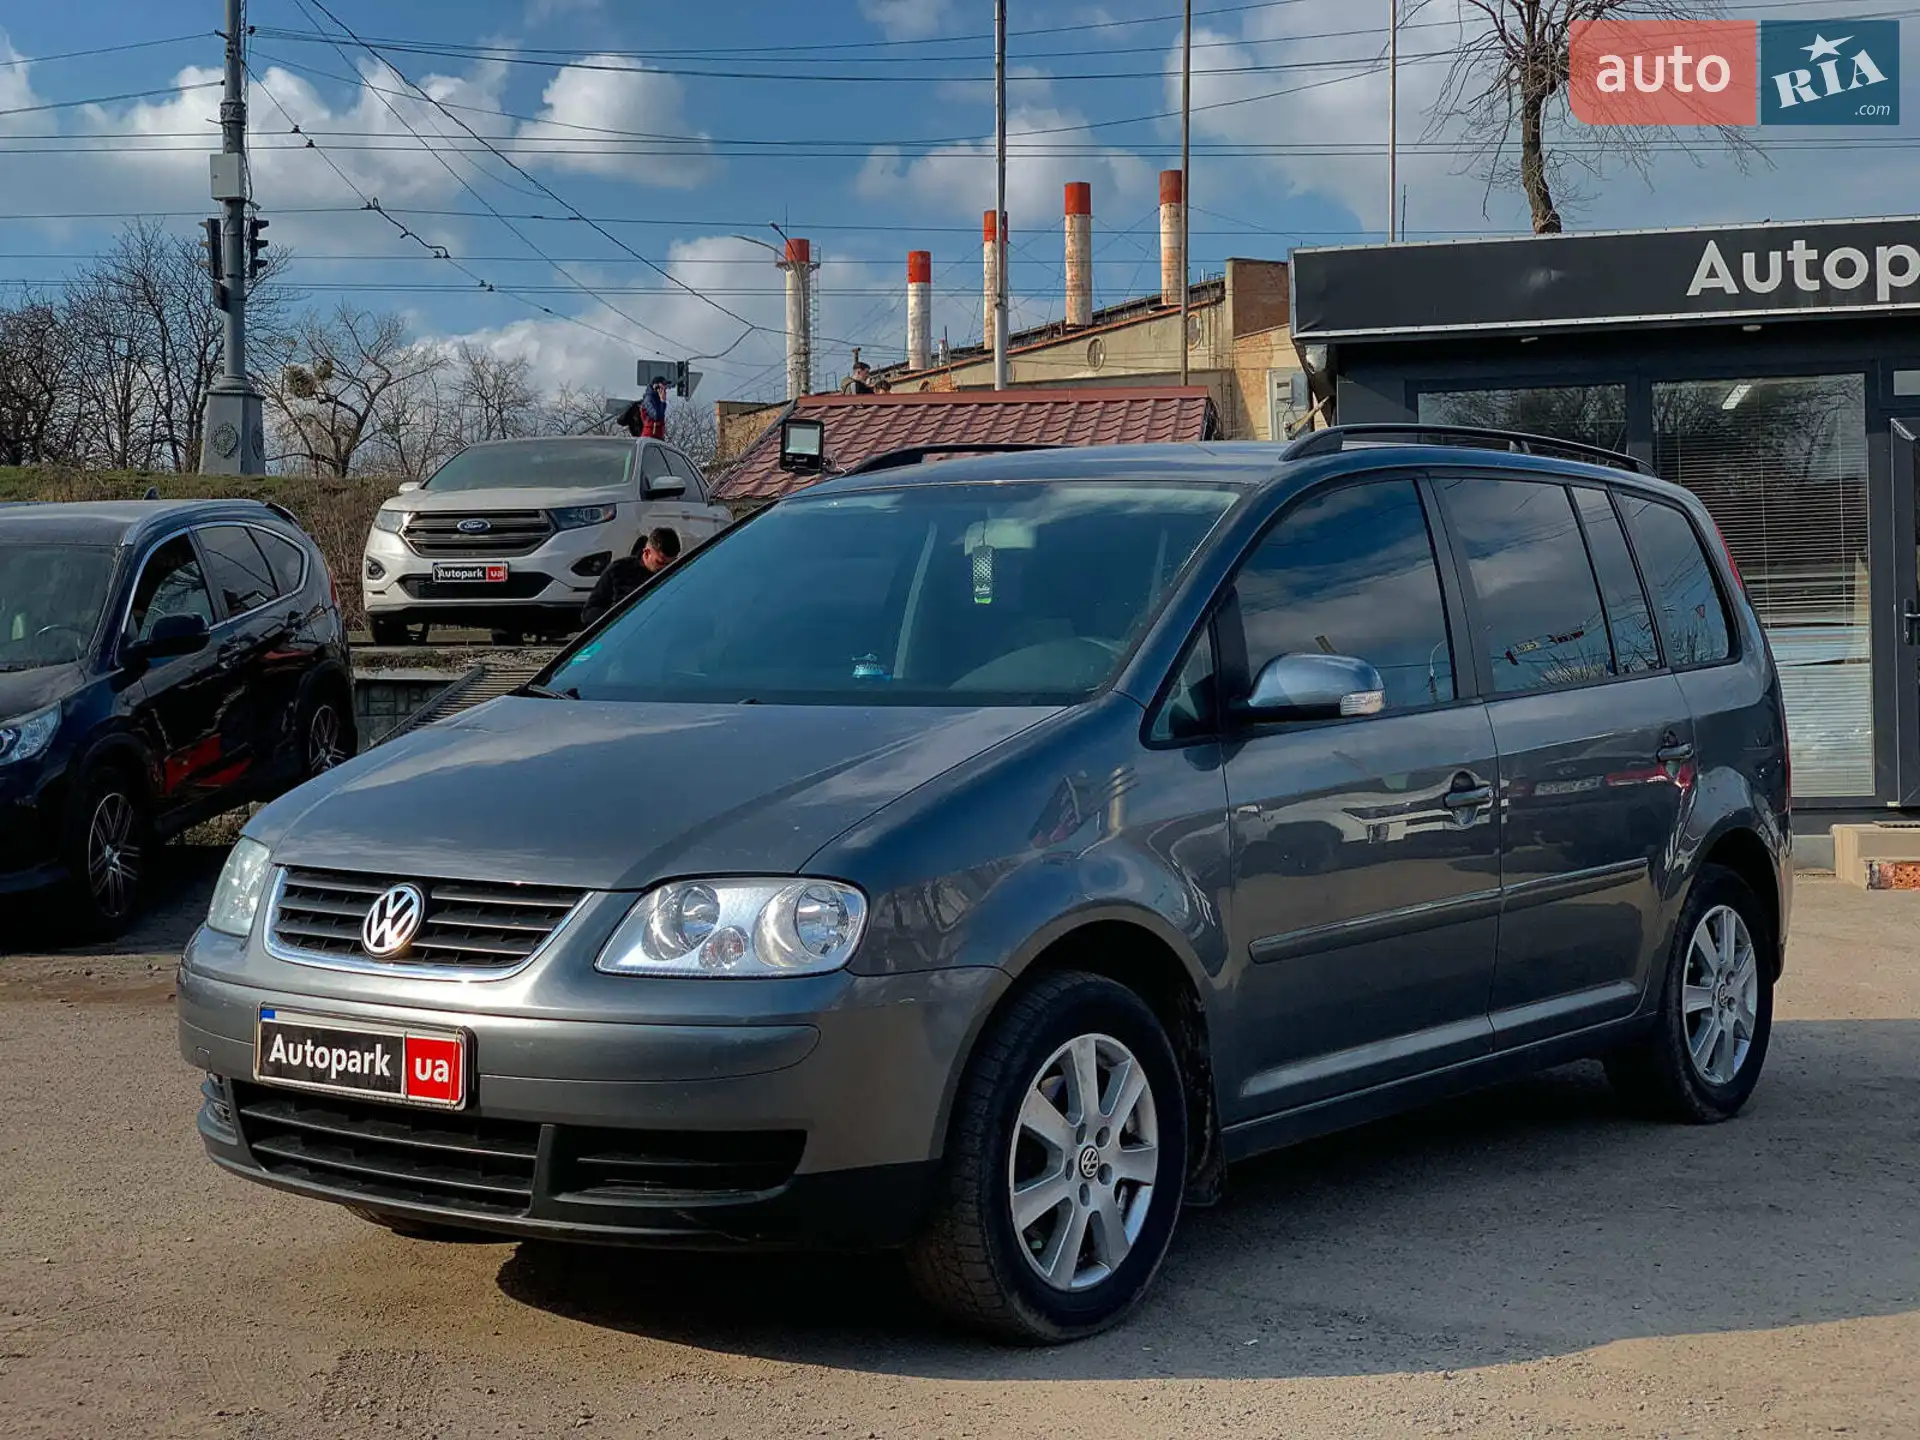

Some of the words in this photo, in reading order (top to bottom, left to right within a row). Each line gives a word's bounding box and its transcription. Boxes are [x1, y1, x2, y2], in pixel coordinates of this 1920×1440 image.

[1686, 239, 1920, 302] Autop
[438, 568, 483, 579] Autopark
[490, 569, 504, 578] ua
[268, 1033, 392, 1080] Autopark
[414, 1056, 449, 1084] ua
